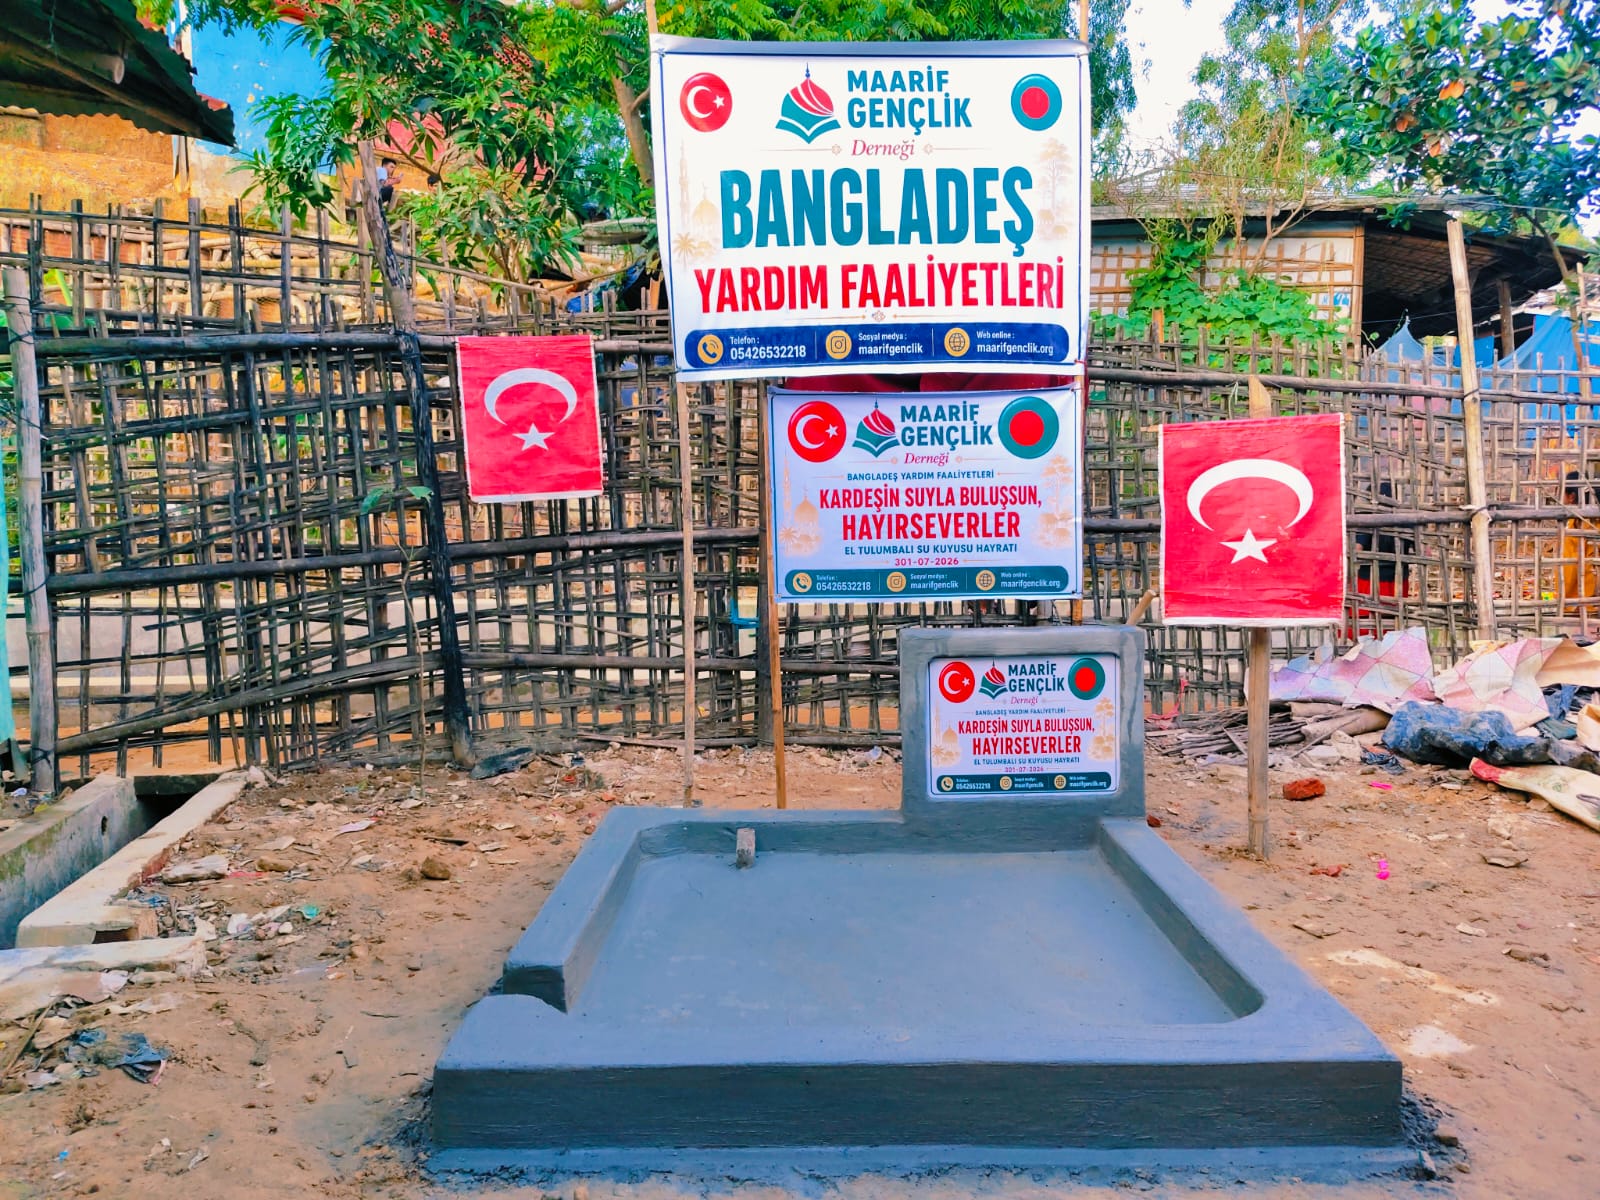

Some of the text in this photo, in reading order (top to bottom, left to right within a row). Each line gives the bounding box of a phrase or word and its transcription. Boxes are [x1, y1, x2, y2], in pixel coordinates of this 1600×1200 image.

[848, 65, 949, 93] MAARİF
[848, 92, 971, 135] GENÇLİK
[851, 139, 915, 160] Derneği
[719, 166, 1034, 257] BANGLADEŞ
[694, 254, 1064, 313] YARDIM FAALİYETLERİ
[730, 336, 756, 344] Telefon
[858, 333, 880, 341] Sosyal
[881, 333, 903, 341] medya
[730, 345, 806, 360] 05426532218
[858, 342, 923, 356] maarifgenclik
[977, 342, 1054, 356] maarifgenclik.org
[901, 401, 979, 422] MAARİF
[901, 421, 993, 451] GENÇLİK
[904, 453, 949, 466] Derneği
[847, 469, 994, 482] BANGLADEŞ YARDIM FAALİYETLERİ
[820, 484, 1042, 511] KARDEŞİN SUYLA BULUŞSUN,
[842, 512, 1020, 540] HAYIRSEVERLER
[845, 543, 1017, 555] EL TULUMBALI SU KUYUSU HAYRATI
[895, 558, 959, 566] 301-07-2026
[816, 581, 871, 591] 05426532218
[911, 580, 959, 590] maarifgenclik
[1008, 661, 1057, 676] MAARİF
[1009, 676, 1064, 695] GENÇLİK
[1011, 696, 1038, 705] Derneği
[959, 718, 1095, 736] KARDEŞİN SUYLA BULUŞSUN,
[972, 736, 1081, 755] HAYIRSEVERLER
